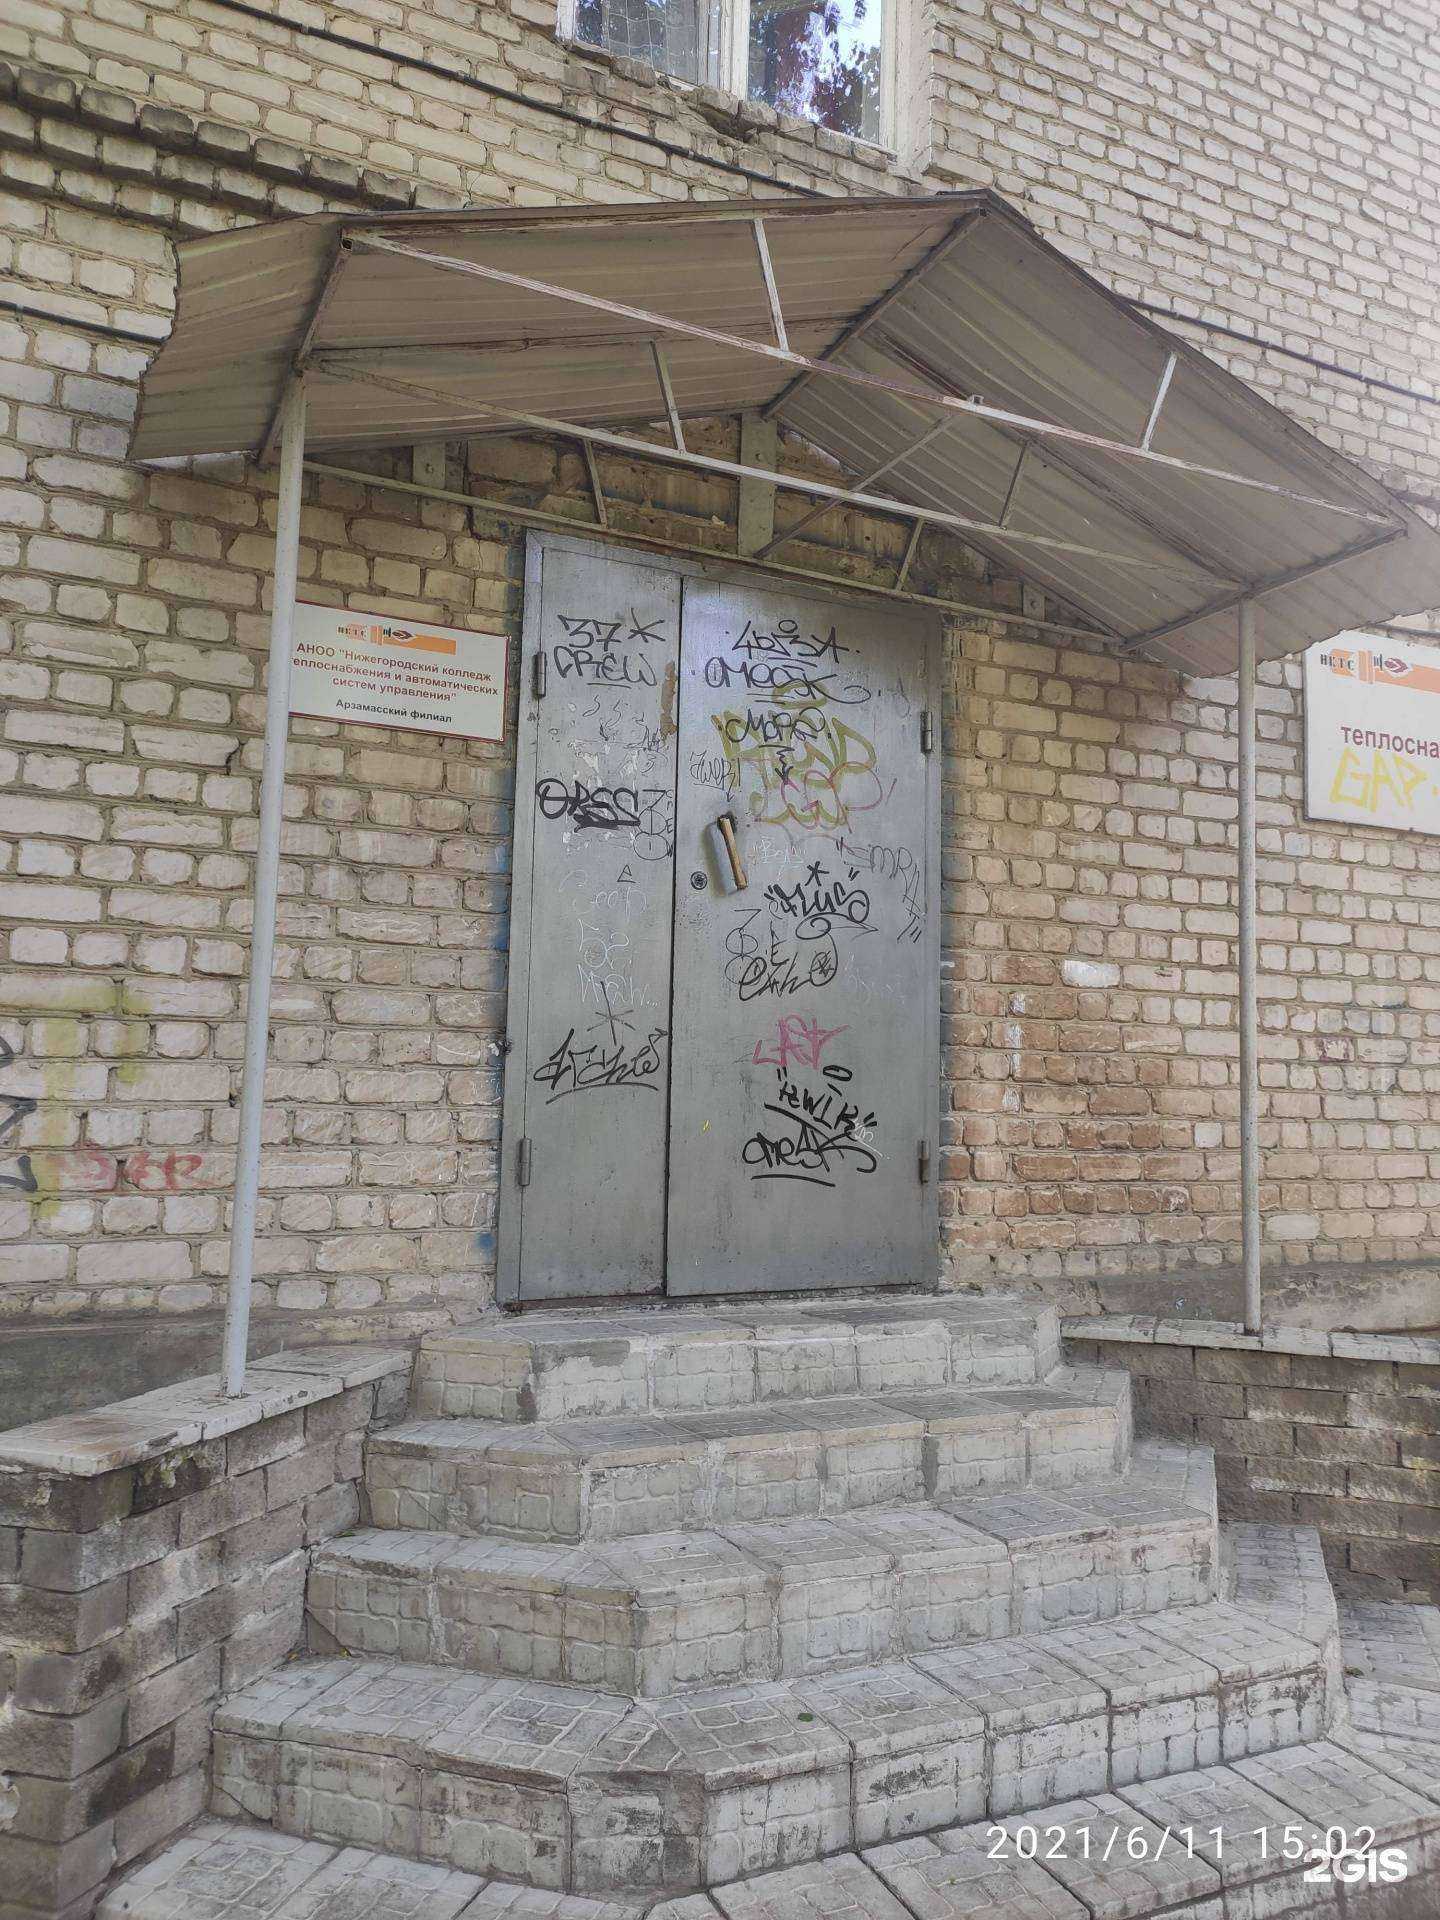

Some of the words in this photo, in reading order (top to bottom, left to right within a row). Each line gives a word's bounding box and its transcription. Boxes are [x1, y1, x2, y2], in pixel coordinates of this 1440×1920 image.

[291, 657, 391, 680] еплоснабжения
[394, 672, 402, 681] и
[405, 674, 498, 695] автоматических
[296, 642, 335, 657] АНОО
[442, 666, 492, 682] колледж
[332, 677, 376, 691] систем
[336, 699, 407, 717] Арзамасский
[410, 709, 452, 723] филиал
